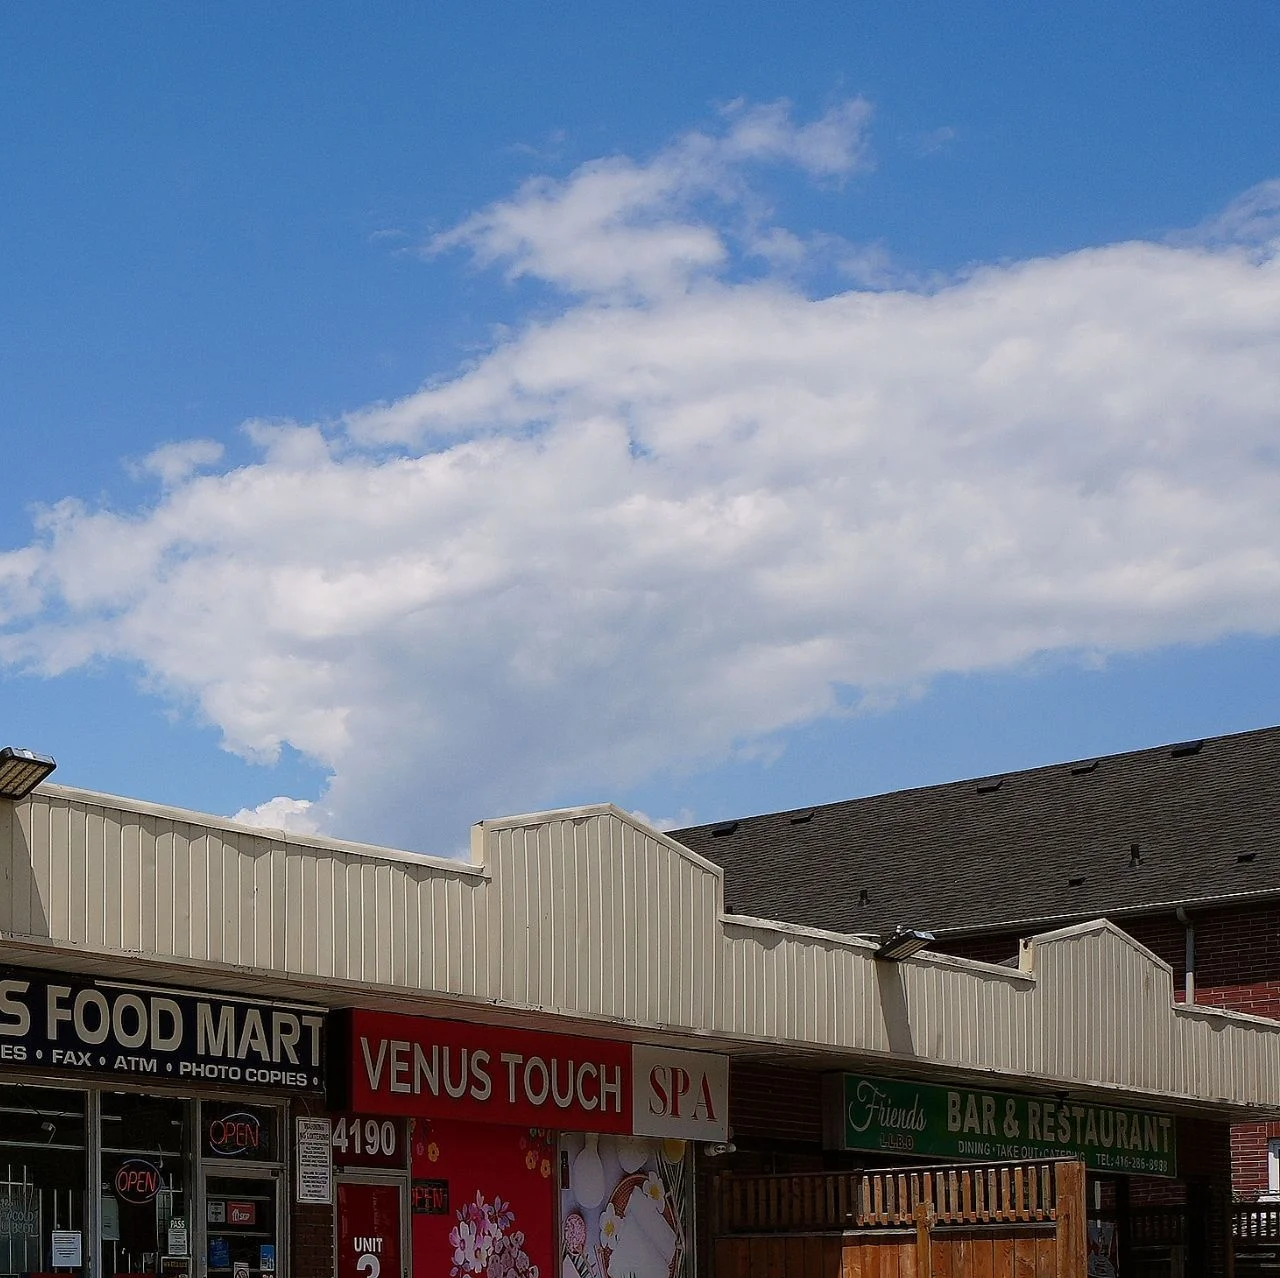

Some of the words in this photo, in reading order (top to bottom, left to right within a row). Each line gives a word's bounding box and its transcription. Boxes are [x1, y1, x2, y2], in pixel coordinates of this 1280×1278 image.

[47, 984, 183, 1052] FOOD
[196, 1002, 323, 1067] MART
[52, 1049, 92, 1067] FAX
[114, 1055, 157, 1073] ATM
[180, 1061, 241, 1080] PHOTO
[246, 1068, 307, 1087] COPIES
[360, 1037, 491, 1101] VENUS
[501, 1052, 621, 1113] TOUCH
[648, 1064, 719, 1123] SPA
[849, 1079, 927, 1132] Friends
[947, 1091, 997, 1136] BAR
[1003, 1098, 1019, 1138] &
[1028, 1102, 1171, 1153] RESTAURANT
[209, 1120, 259, 1147] OPEN
[333, 1118, 396, 1155] 4190
[958, 1140, 991, 1156] DINING
[996, 1144, 1019, 1159] TAKE
[1021, 1146, 1039, 1161] OUT
[117, 1171, 157, 1193] OPEN
[170, 1220, 185, 1229] PASS
[354, 1237, 383, 1253] UNIT
